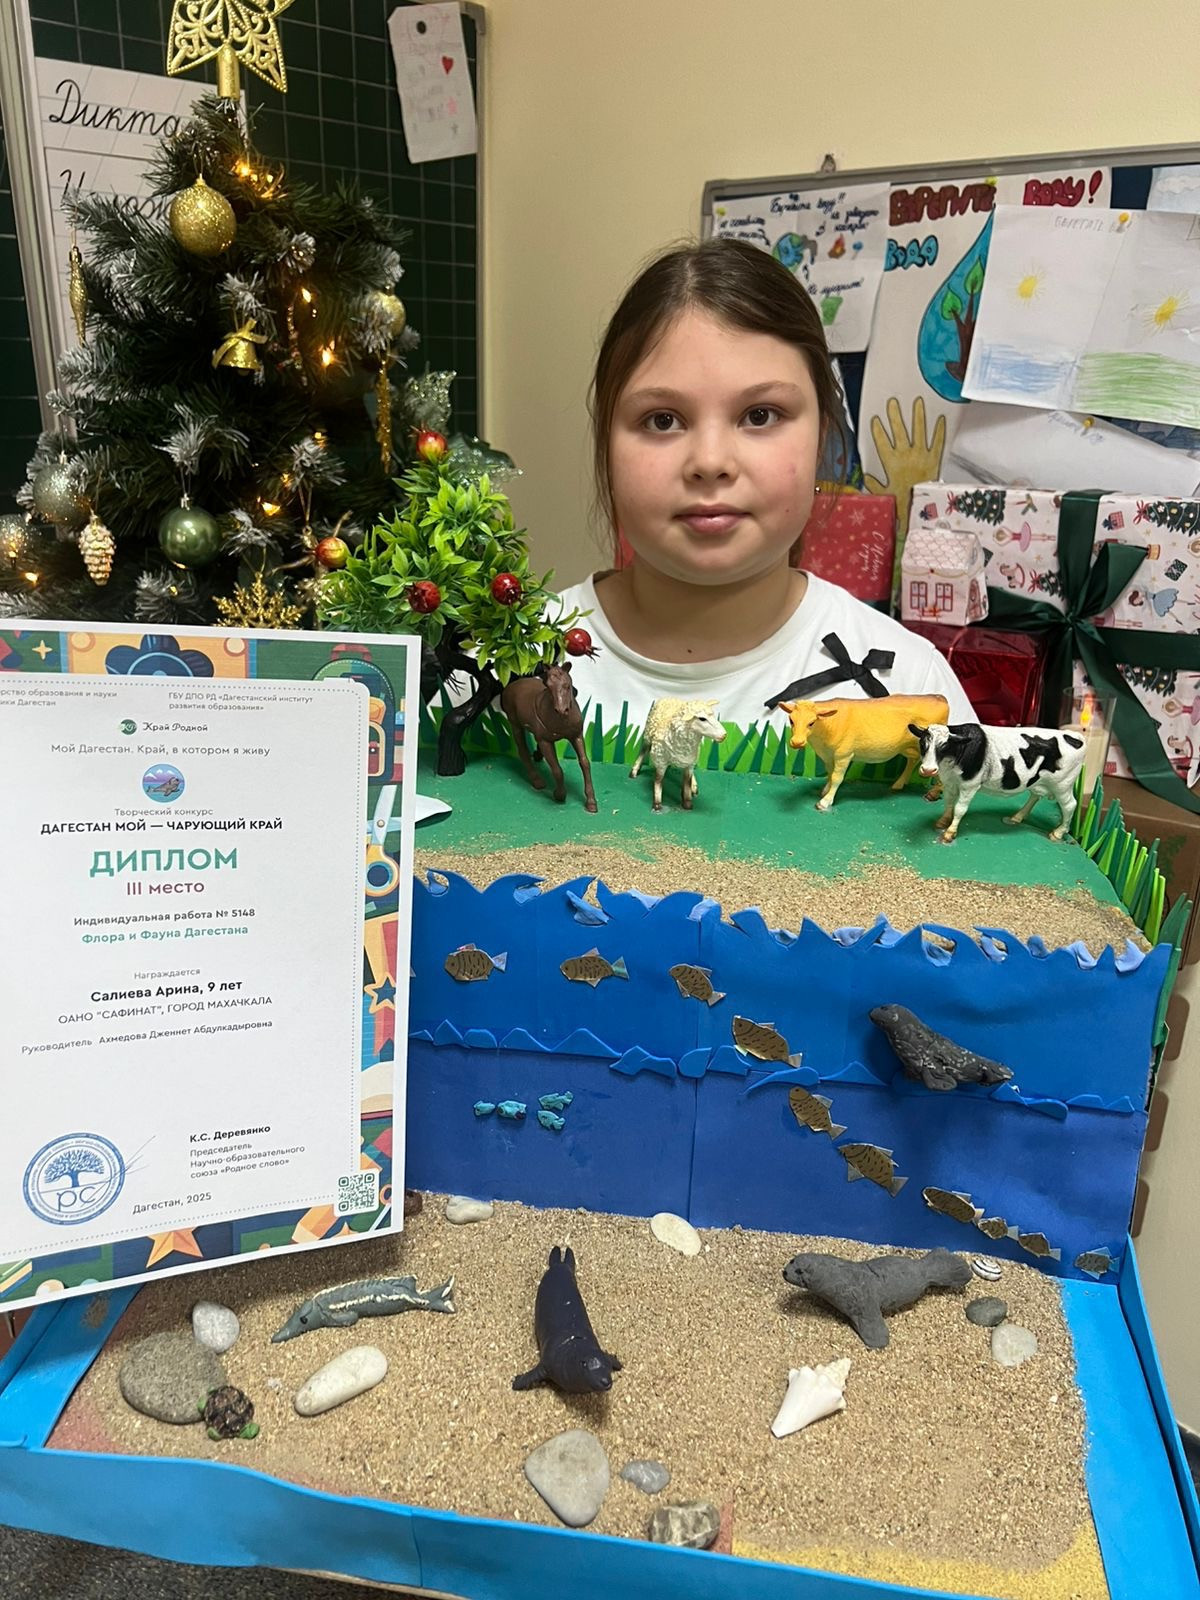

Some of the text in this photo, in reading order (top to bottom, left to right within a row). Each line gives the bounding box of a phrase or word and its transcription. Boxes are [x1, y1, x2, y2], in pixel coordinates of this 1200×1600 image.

[49, 79, 181, 137] Дикта
[28, 688, 83, 698] образования
[93, 691, 118, 699] науки
[168, 692, 313, 704] ГБУ ДПО РД «Дагестанский институт
[17, 699, 56, 707] Дагестан
[168, 702, 264, 712] развития образования»
[143, 721, 208, 733] Край Родной
[51, 744, 75, 753] Мой
[78, 744, 134, 754] Дагестан.
[137, 744, 169, 755] Край,
[182, 747, 230, 756] котором
[233, 747, 239, 755] я
[242, 748, 271, 757] живу
[114, 807, 214, 818] Творческий конкурс
[41, 821, 111, 835] ДАГЕСТАН
[115, 818, 146, 831] МОЙ
[166, 818, 246, 832] ЧАРУЮЩИЙ
[250, 817, 283, 830] КРАЙ
[90, 848, 237, 877] ДИПЛОМ
[127, 882, 205, 896] III место
[74, 908, 256, 926] Индивидуальная работа № 5148
[82, 925, 249, 944] Флора и Фауна Дагестана
[134, 968, 201, 981] Награждается
[91, 980, 243, 1002] Салиева Арина, 9 лет
[58, 1012, 94, 1024] ОАНО
[167, 1002, 205, 1014] ГОРОД
[207, 996, 273, 1009] МАХАЧКАЛА
[21, 1020, 273, 1054] Руководитель Ахмедова Дженнет Абдулкадыровна
[189, 1125, 271, 1143] К.С. Деревянко
[189, 1142, 253, 1157] Председатель
[190, 1145, 306, 1169] Научно-образовательного
[190, 1159, 290, 1179] союза «Родное слово»
[132, 1191, 212, 1215] Дагестан, 2025
